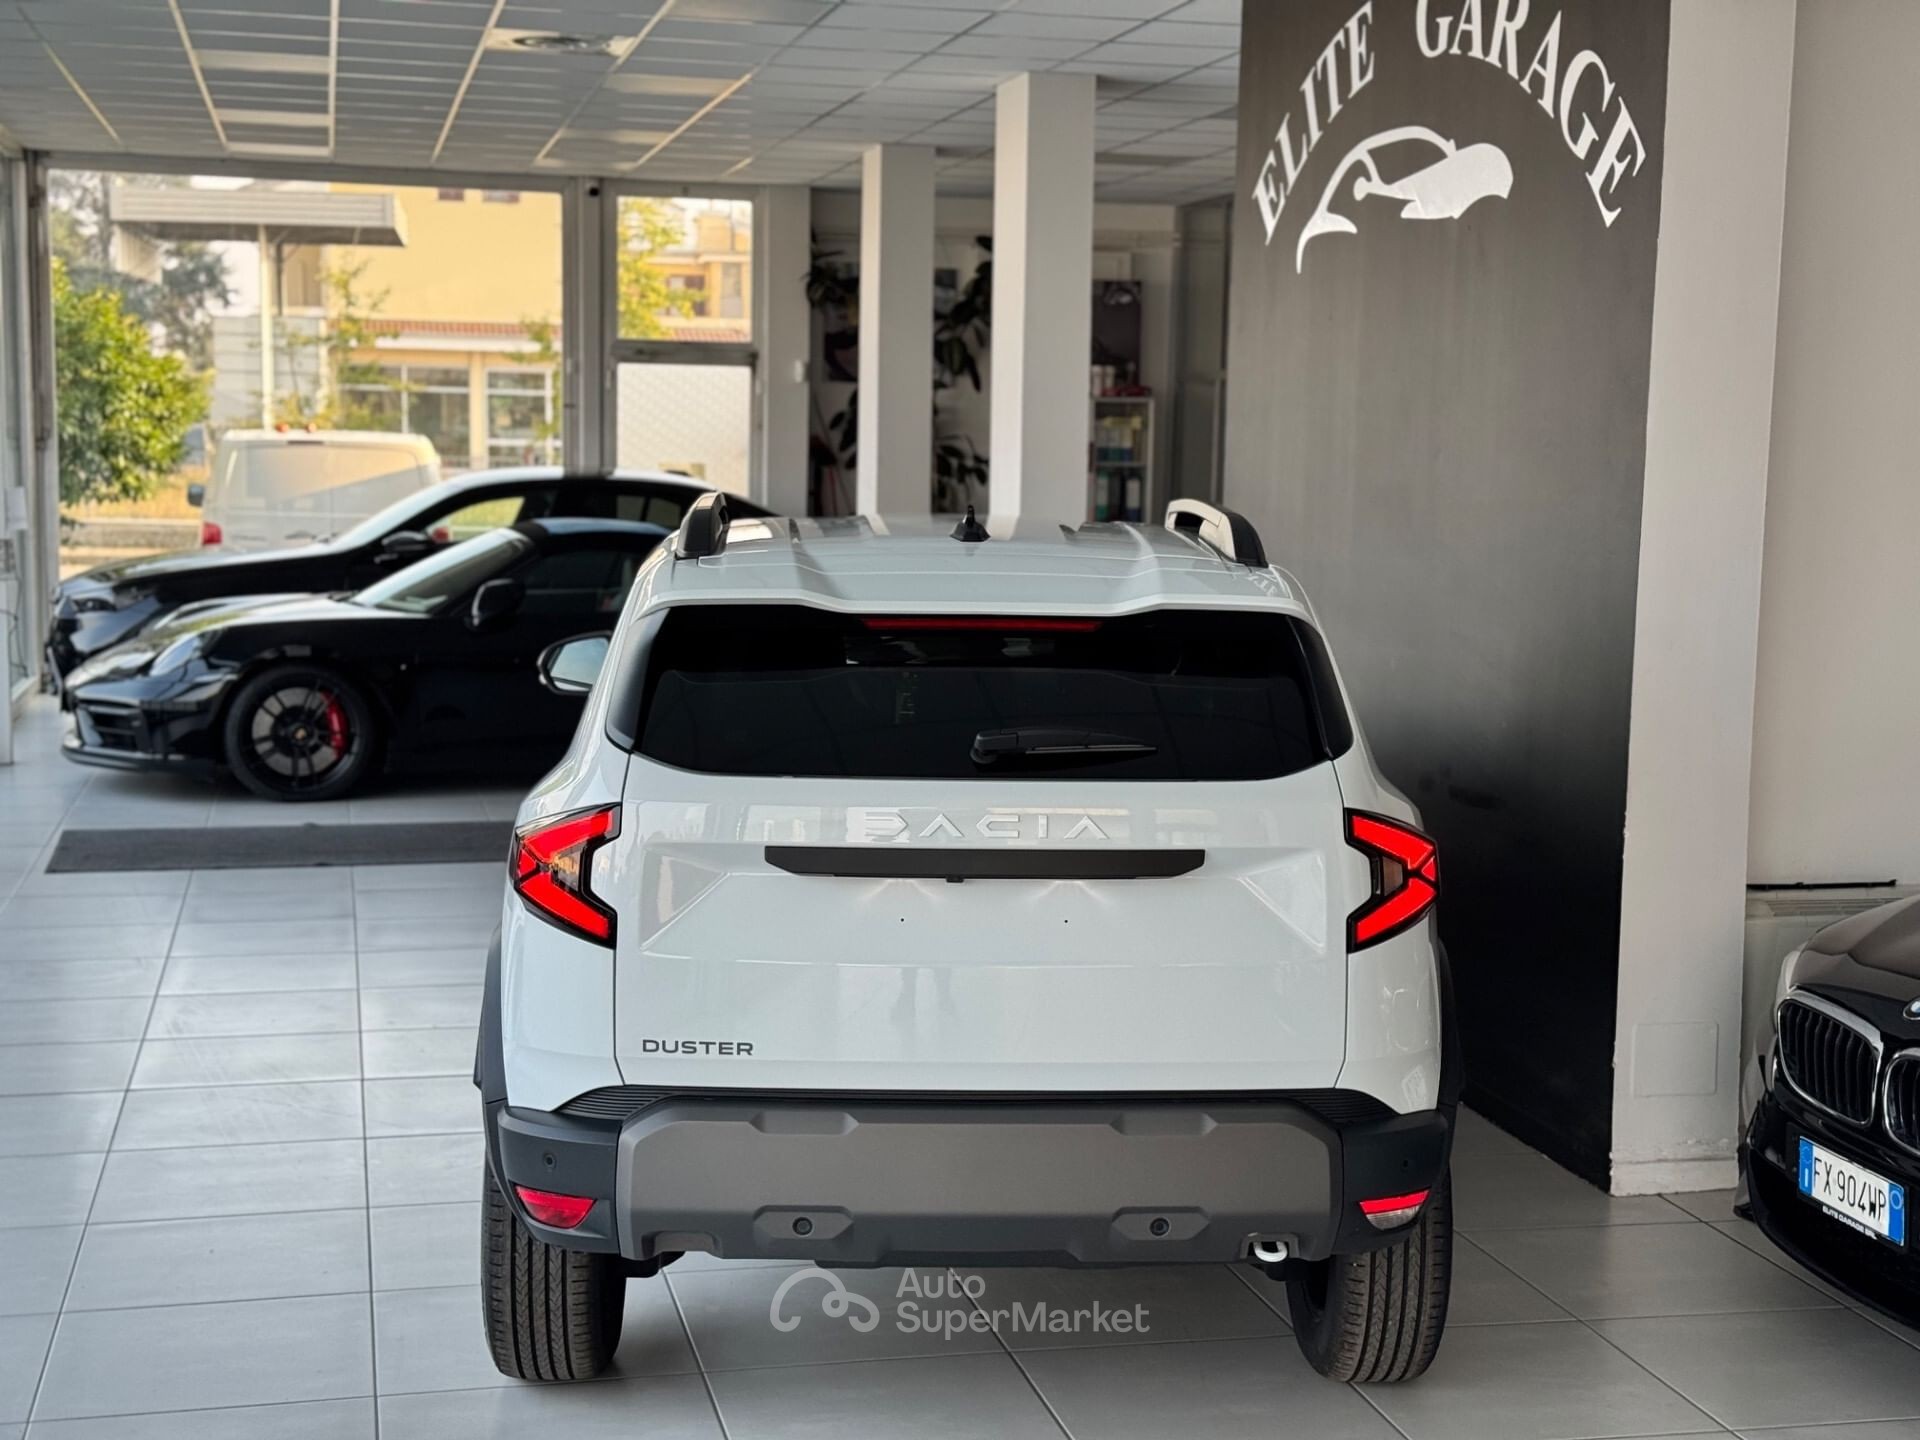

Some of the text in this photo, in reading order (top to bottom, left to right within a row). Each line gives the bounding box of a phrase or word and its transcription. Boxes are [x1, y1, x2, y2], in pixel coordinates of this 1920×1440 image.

[1251, 0, 1646, 246] ELITE GARAGE
[863, 812, 1110, 840] DACIA
[642, 1039, 753, 1056] DUSTER
